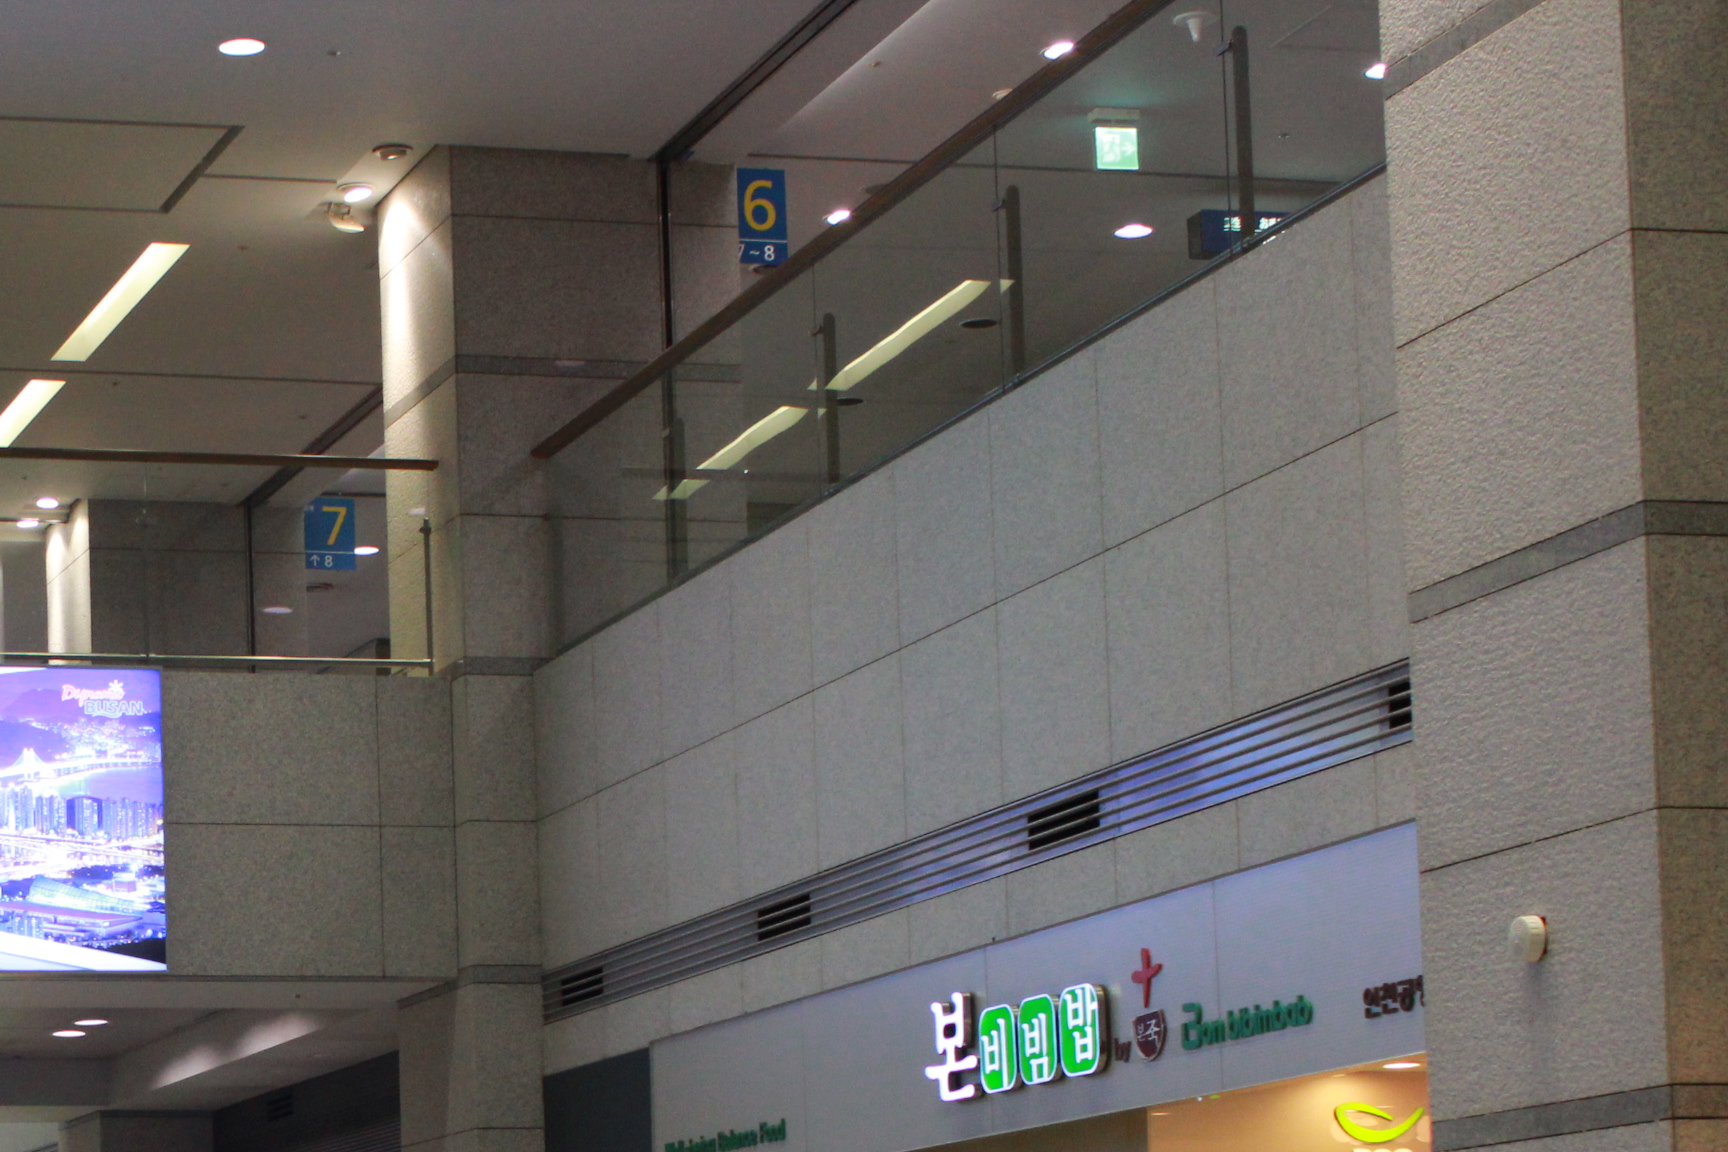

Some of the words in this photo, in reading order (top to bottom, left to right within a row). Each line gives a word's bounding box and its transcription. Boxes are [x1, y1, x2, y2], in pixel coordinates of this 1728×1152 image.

[744, 180, 777, 231] 6
[322, 506, 347, 545] 7
[324, 555, 333, 568] 8
[84, 700, 144, 716] BUSAN
